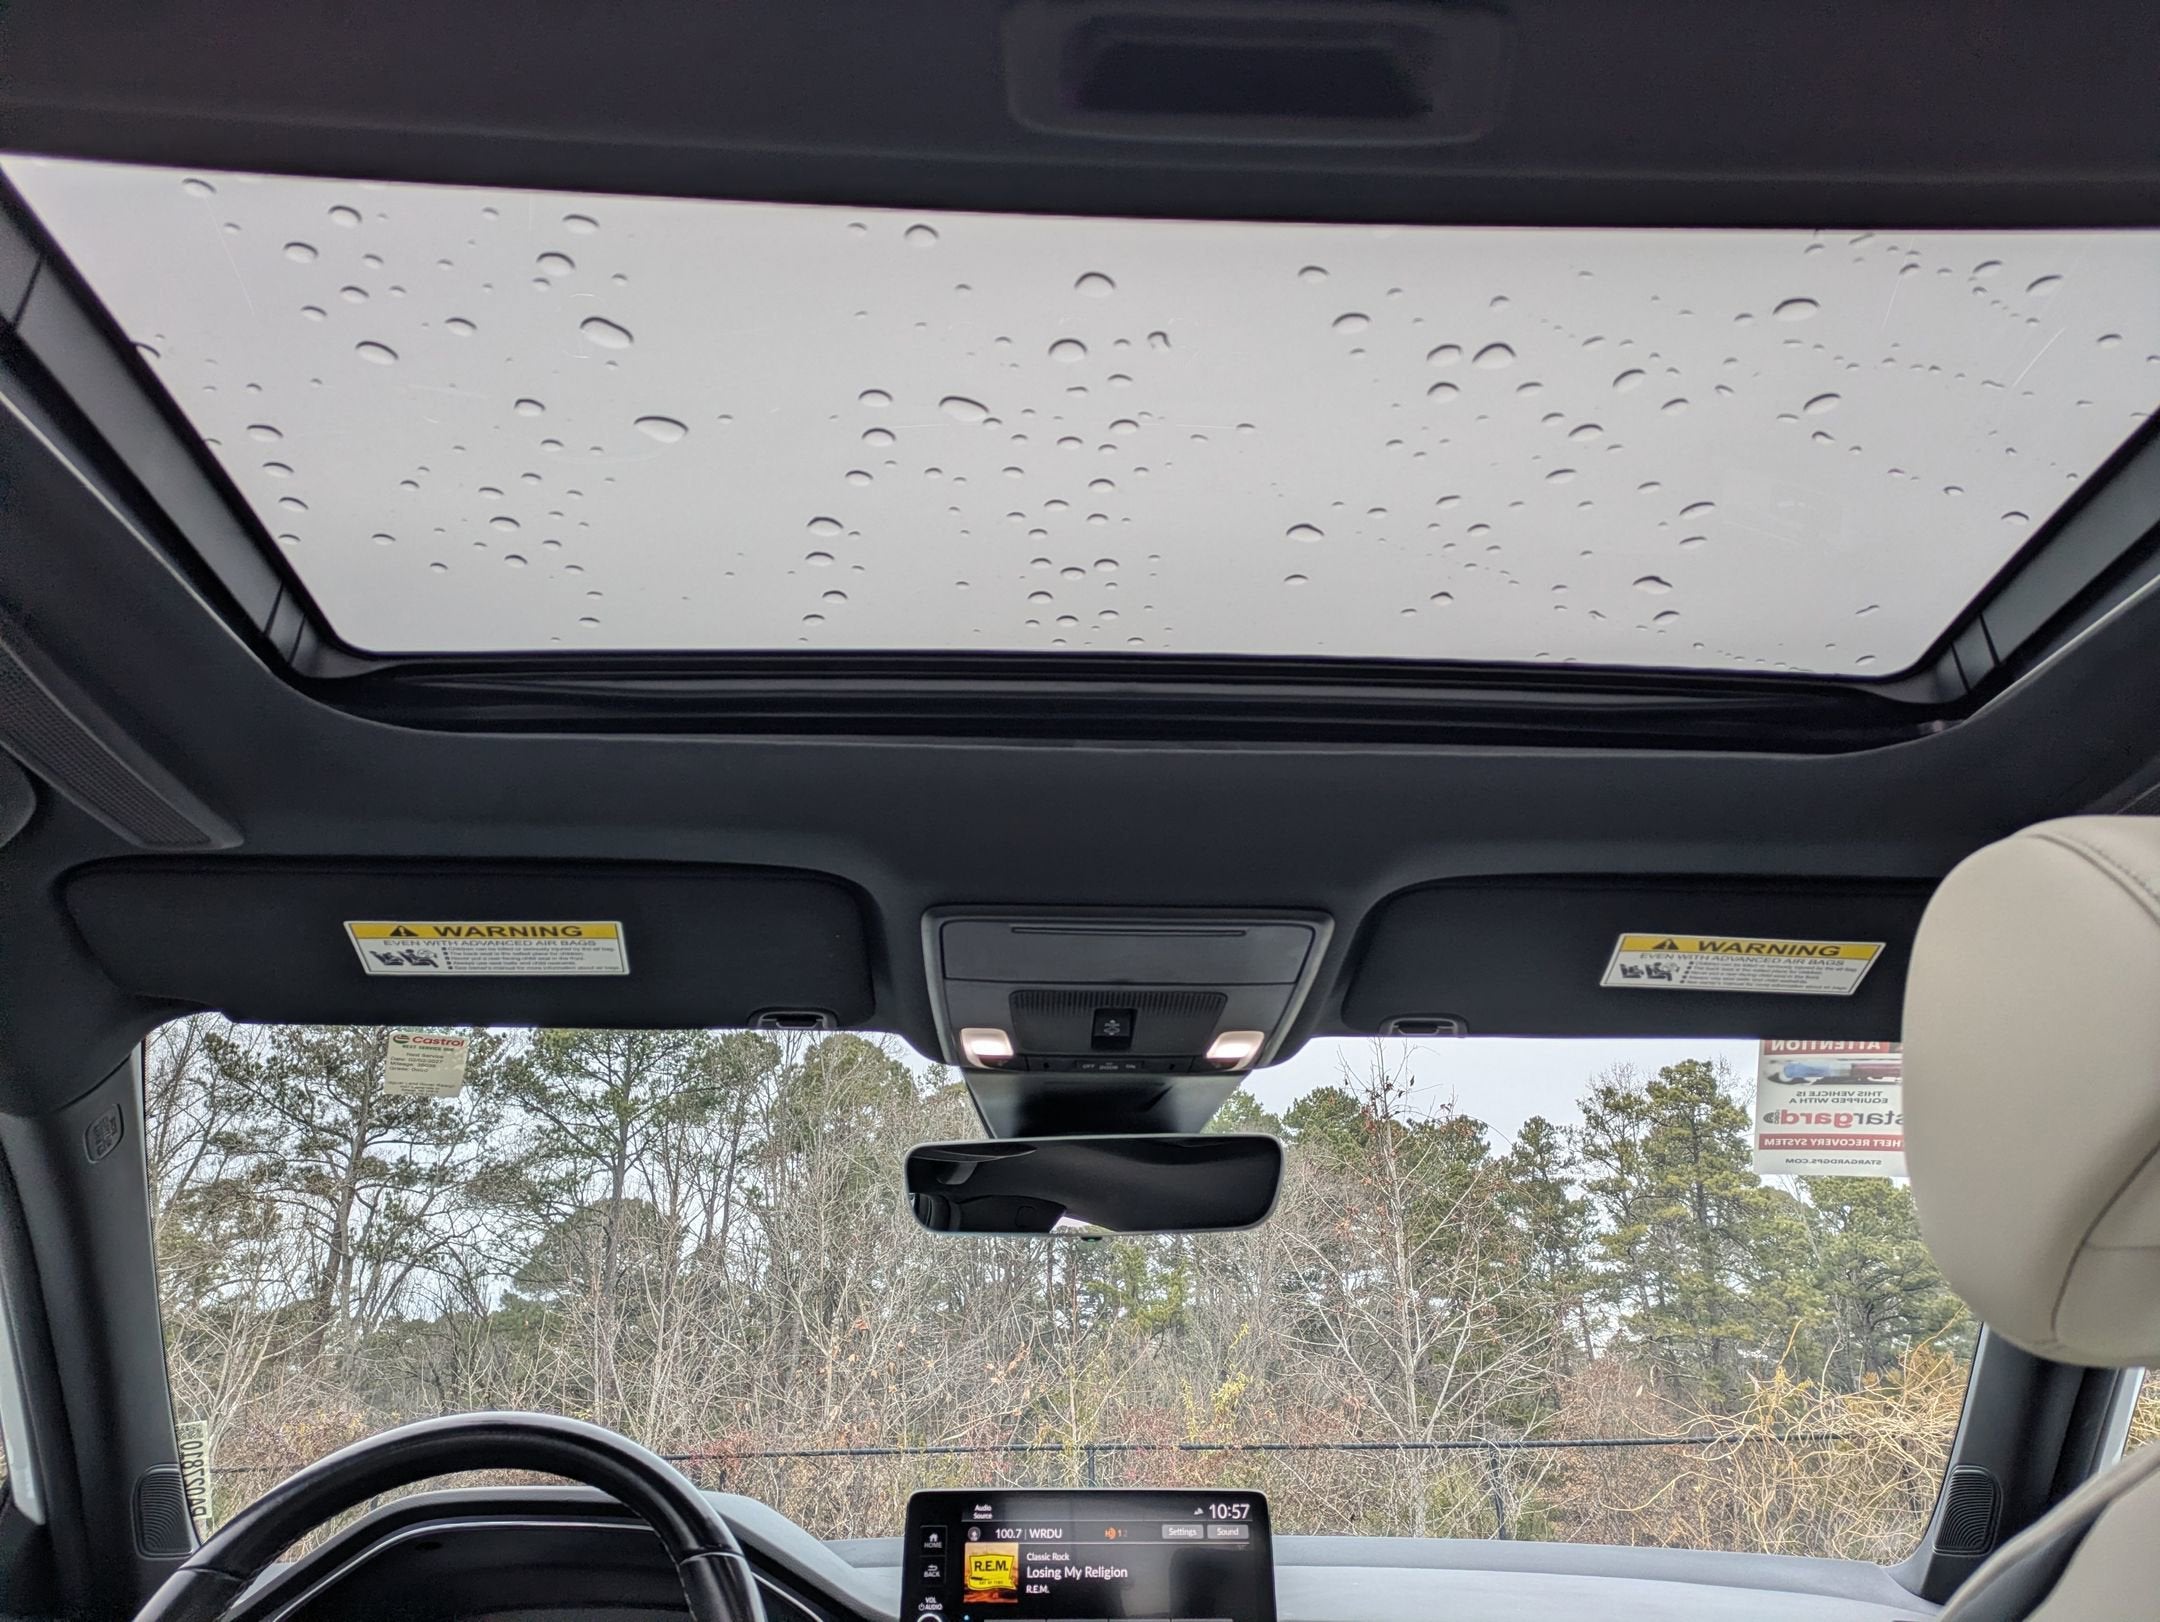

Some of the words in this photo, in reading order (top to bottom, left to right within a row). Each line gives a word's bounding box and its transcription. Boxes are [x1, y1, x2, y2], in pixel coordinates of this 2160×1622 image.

[433, 925, 583, 938] WARNING
[1697, 940, 1841, 957] WARNING
[1639, 953, 1673, 961] EVEN
[1677, 954, 1712, 962] WITH
[1712, 956, 1782, 964] ADVANCED
[412, 1036, 465, 1047] Castrol
[974, 1504, 992, 1512] Audio
[1209, 1503, 1250, 1519] 10:57
[973, 1512, 993, 1520] Source
[995, 1527, 1022, 1539] 100.7
[1029, 1527, 1063, 1539] WRDU
[1168, 1527, 1198, 1538] Settings
[1216, 1527, 1239, 1536] Sound
[1026, 1552, 1051, 1561] Classic
[1052, 1552, 1070, 1561] Rock
[974, 1560, 1009, 1572] R.E.M.
[1026, 1565, 1062, 1580] Losing
[1064, 1566, 1083, 1580] My
[1084, 1565, 1128, 1580] Religion
[925, 1596, 937, 1604] VOL
[925, 1603, 943, 1611] AUDIO
